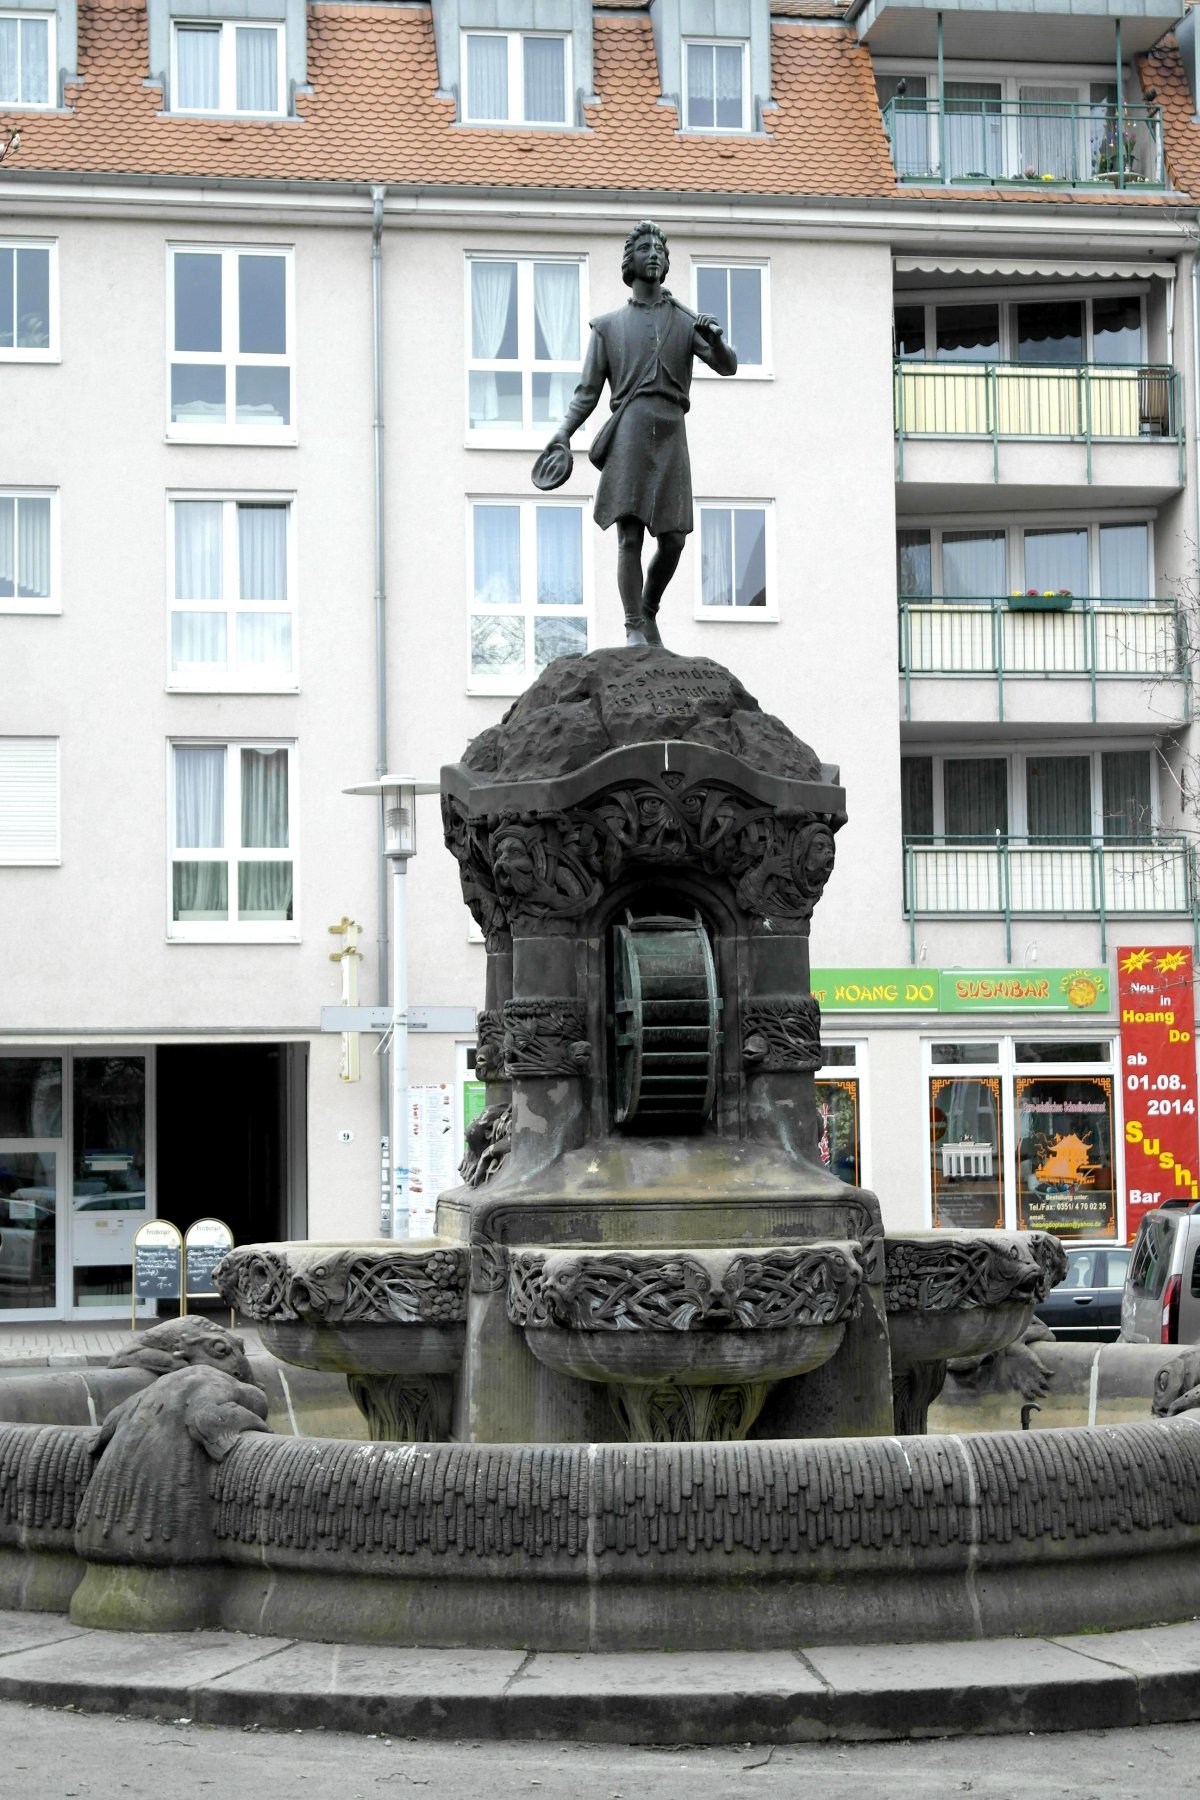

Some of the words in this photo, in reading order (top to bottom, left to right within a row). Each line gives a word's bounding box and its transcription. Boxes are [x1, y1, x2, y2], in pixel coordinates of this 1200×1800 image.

[645, 668, 729, 681] Wandern
[614, 692, 639, 708] ist
[644, 689, 674, 701] des
[651, 701, 697, 715] Lust.
[834, 984, 898, 1001] HOANG
[905, 984, 934, 1002] DO
[956, 979, 1050, 999] SUSHIBAR
[1130, 983, 1154, 993] Neu
[1160, 995, 1171, 1006] in
[1123, 1010, 1175, 1025] Hoang
[1169, 1030, 1190, 1042] Do
[1127, 1053, 1148, 1065] ab
[1127, 1075, 1187, 1090] 01.08.
[1147, 1099, 1195, 1115] 2014
[1125, 1120, 1199, 1200] Sushi
[1129, 1190, 1161, 1204] Bar
[1098, 1202, 1107, 1210] 35
